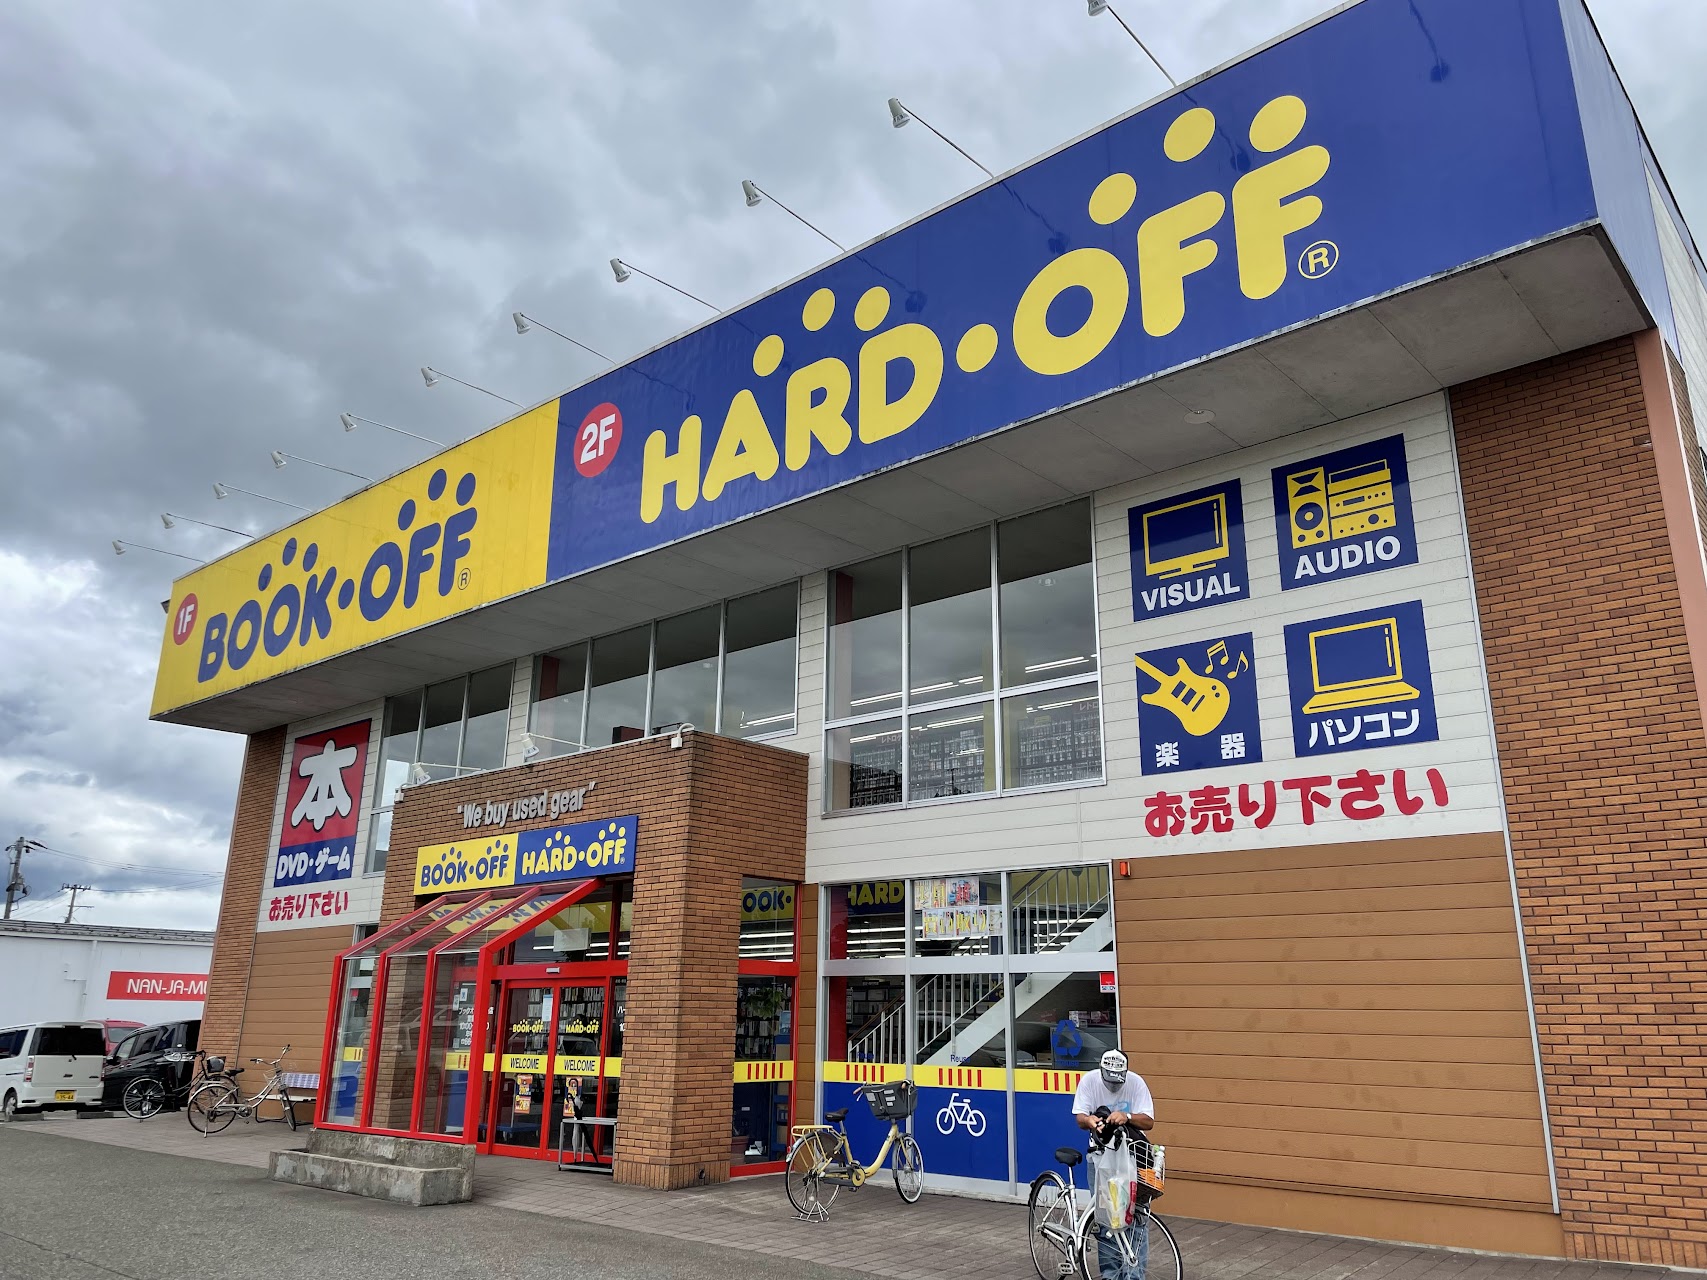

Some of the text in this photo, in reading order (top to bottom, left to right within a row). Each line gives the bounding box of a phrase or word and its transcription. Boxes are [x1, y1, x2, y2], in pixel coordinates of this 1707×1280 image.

[581, 413, 616, 465] 2F
[1294, 535, 1401, 580] AUDIO
[1140, 572, 1241, 612] VISUAL
[176, 603, 195, 635] 1F
[1308, 708, 1421, 749] パソコン
[290, 739, 359, 832] 本
[1143, 767, 1450, 838] お売り下さい
[484, 800, 509, 827] buy
[512, 789, 548, 820] used
[268, 890, 349, 922] お売り下さい
[510, 1057, 540, 1070] WELCOME
[563, 1059, 596, 1072] WELCOME
[950, 1054, 971, 1063] Reuse
